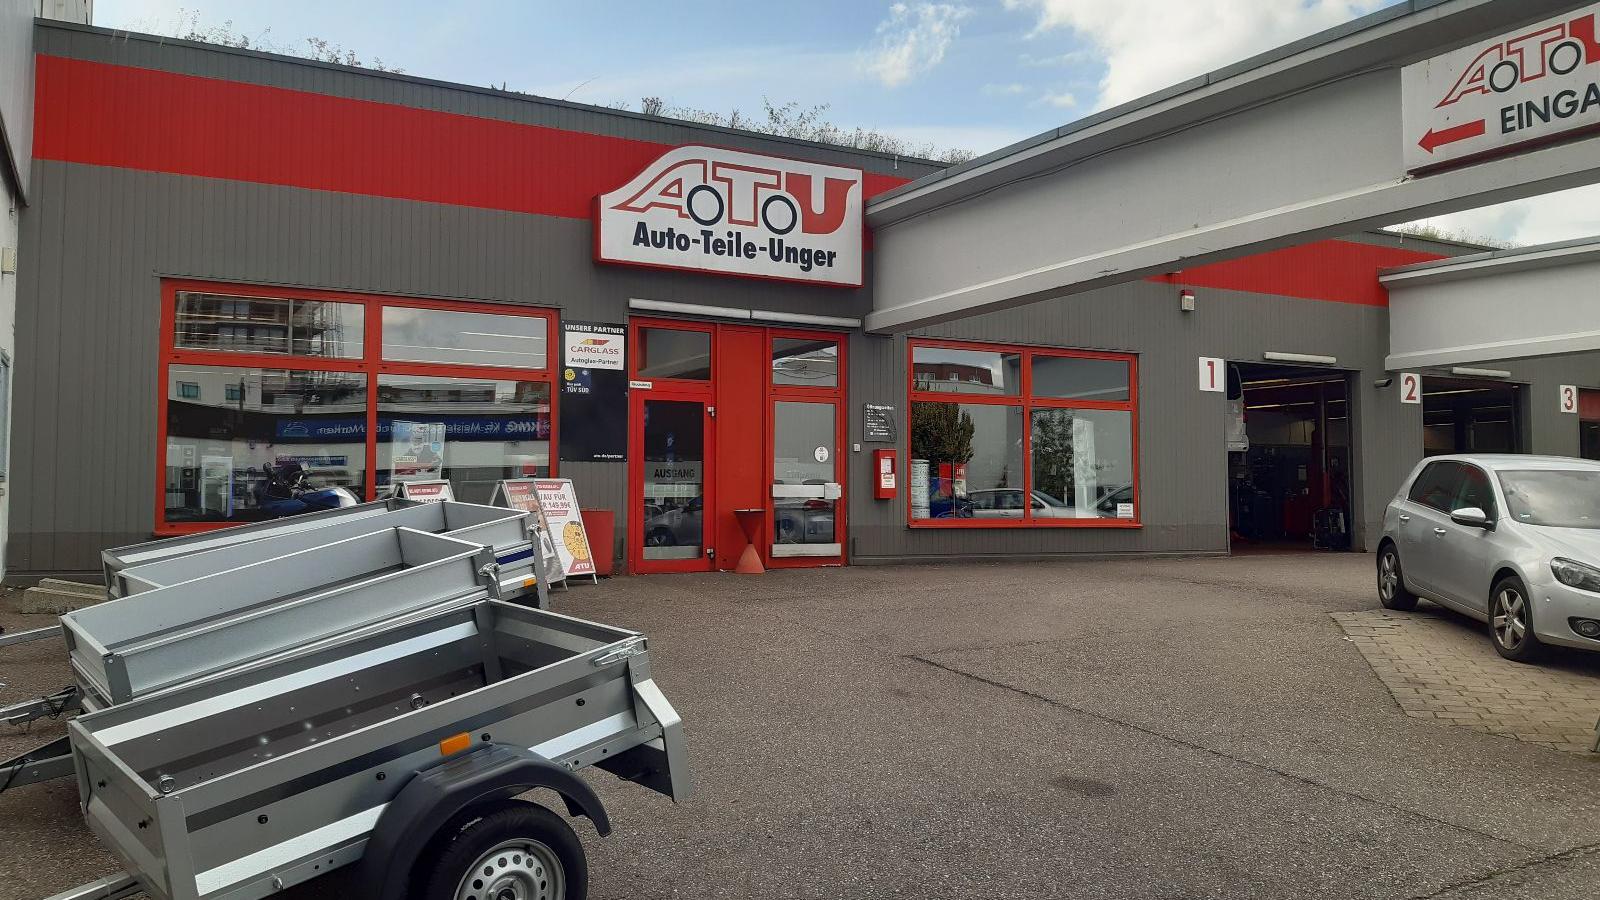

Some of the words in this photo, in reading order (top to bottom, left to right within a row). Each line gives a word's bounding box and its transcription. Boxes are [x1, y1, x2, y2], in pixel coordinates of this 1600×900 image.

[632, 221, 837, 272] Auto-Teile-Unger
[565, 324, 592, 332] UNSERE
[593, 326, 625, 334] PARTNER
[570, 345, 619, 355] CARGLASS
[570, 357, 619, 366] Autoglas-Partner
[1207, 361, 1215, 389] 1
[566, 385, 578, 393] TÜV
[1404, 376, 1417, 401] 2
[1564, 387, 1574, 409] 3
[654, 468, 696, 479] AUSGANG
[575, 562, 590, 570] ATU
